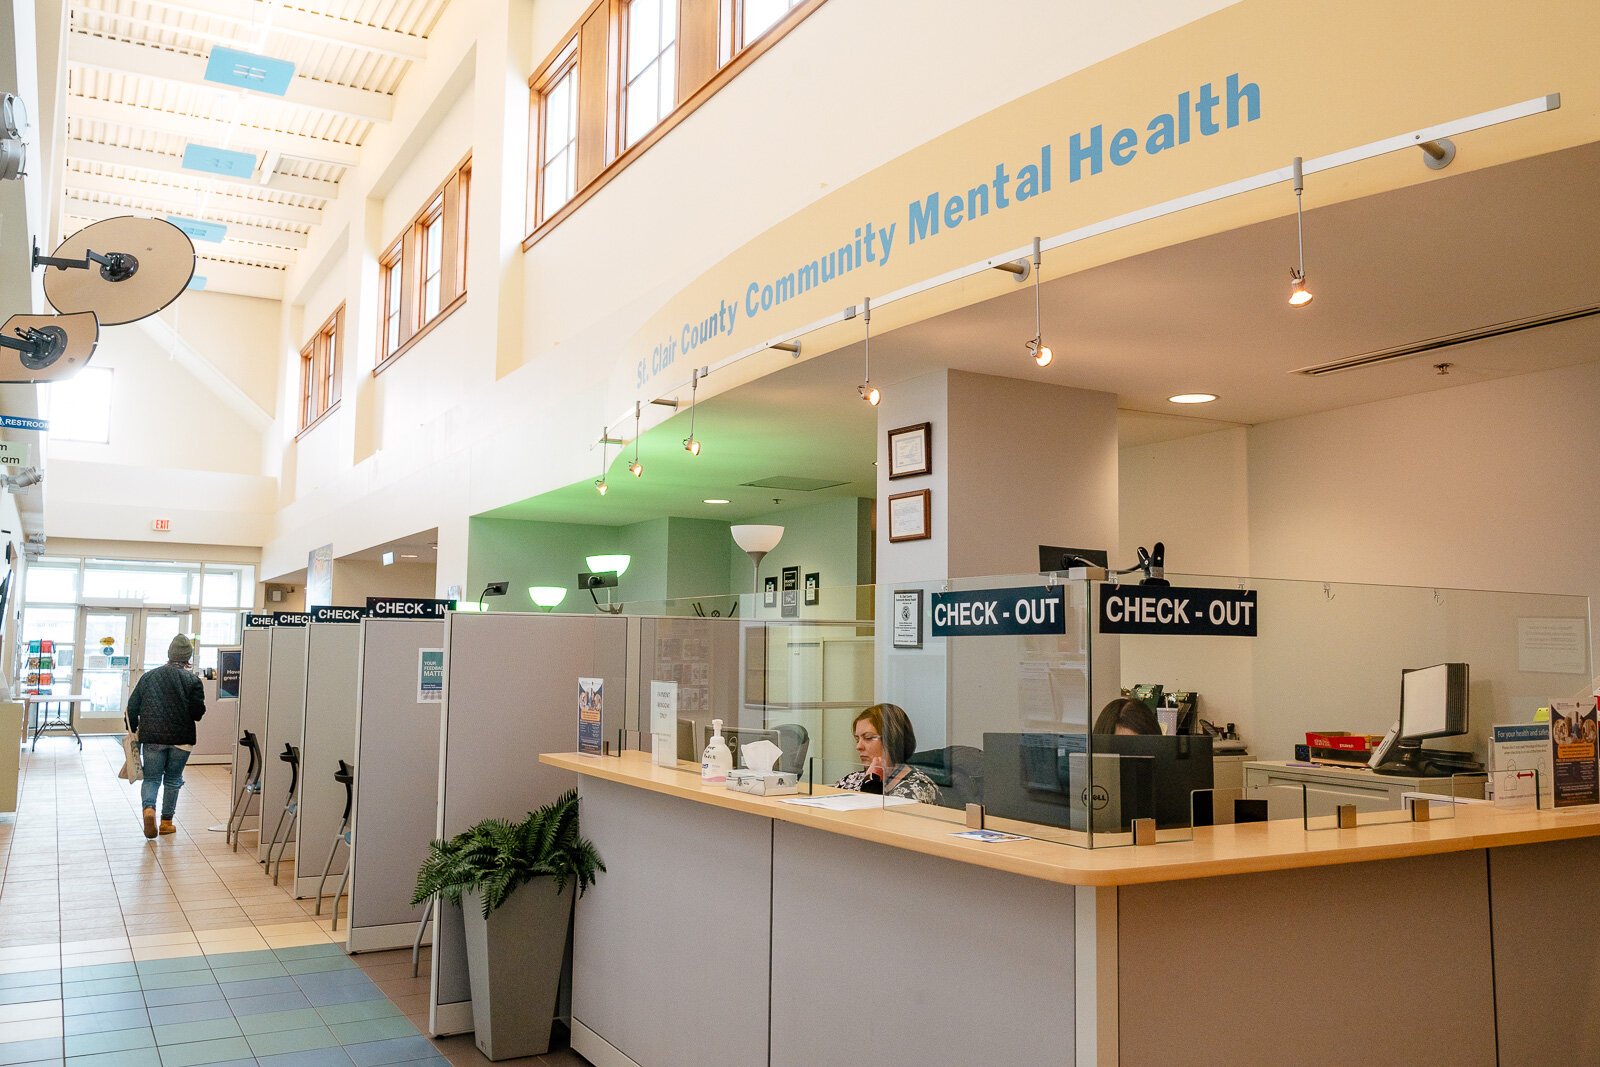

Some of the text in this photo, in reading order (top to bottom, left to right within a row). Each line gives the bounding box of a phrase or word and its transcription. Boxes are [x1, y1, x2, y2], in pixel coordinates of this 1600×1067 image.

[636, 72, 1261, 388] St. Clair County Community Mental Health
[156, 520, 170, 529] EXIT
[319, 610, 359, 620] CHECK
[376, 602, 424, 614] CHECK
[435, 604, 448, 614] IN
[934, 600, 998, 626] CHECK
[1015, 597, 1060, 624] OUT
[1106, 596, 1190, 624] CHECK
[1209, 600, 1254, 626] OUT
